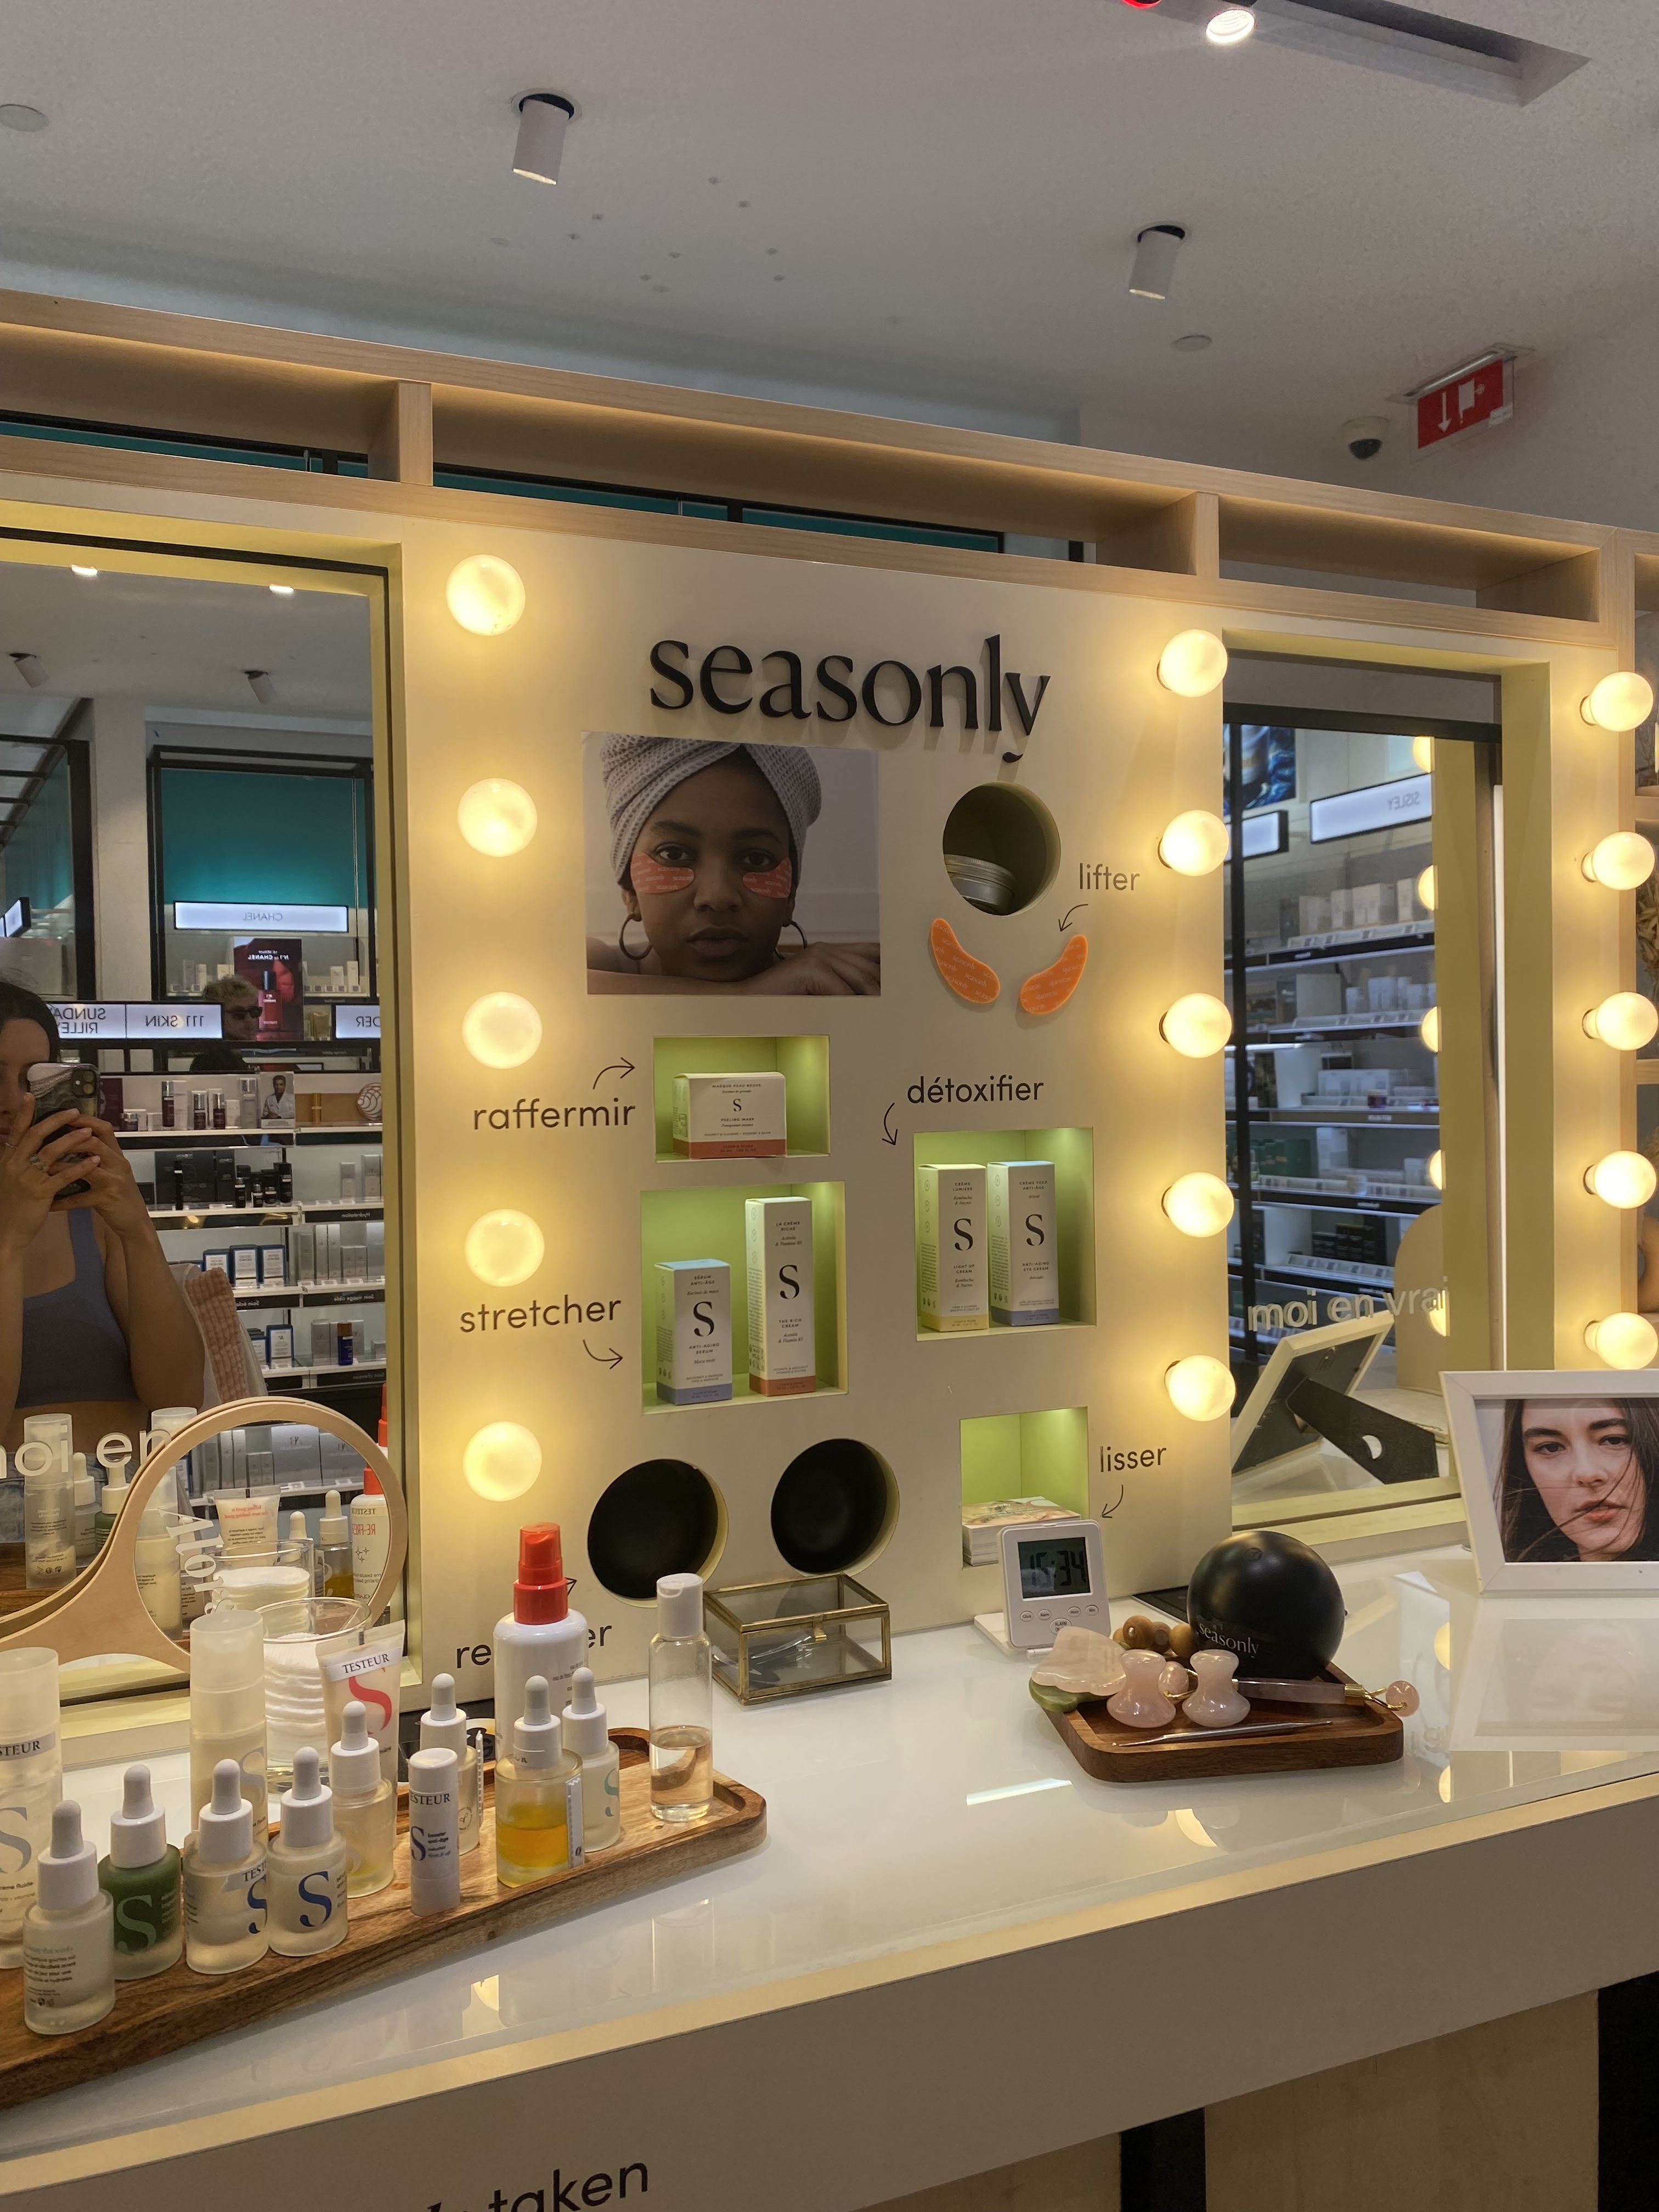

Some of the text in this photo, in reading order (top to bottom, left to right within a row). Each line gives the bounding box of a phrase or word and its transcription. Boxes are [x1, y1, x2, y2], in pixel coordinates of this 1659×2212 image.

[650, 634, 1051, 764] seasonly
[1079, 862, 1140, 890] lifter
[733, 1098, 742, 1112] S
[907, 1074, 1044, 1104] détoxifier
[473, 1097, 636, 1130] raffermir
[953, 1218, 973, 1251] S
[1025, 1214, 1045, 1246] S
[779, 1265, 800, 1299] S
[460, 1294, 621, 1333] stretcher
[693, 1301, 714, 1337] S
[1248, 1276, 1449, 1331] moi en vrai
[0, 1425, 69, 1479] oi
[1100, 1446, 1166, 1472] lisser
[1199, 1623, 1259, 1658] seasonly
[342, 1654, 390, 1674] TESTEUR
[411, 1826, 426, 1861] S
[298, 1871, 332, 1927] S
[116, 1894, 156, 1955] S
